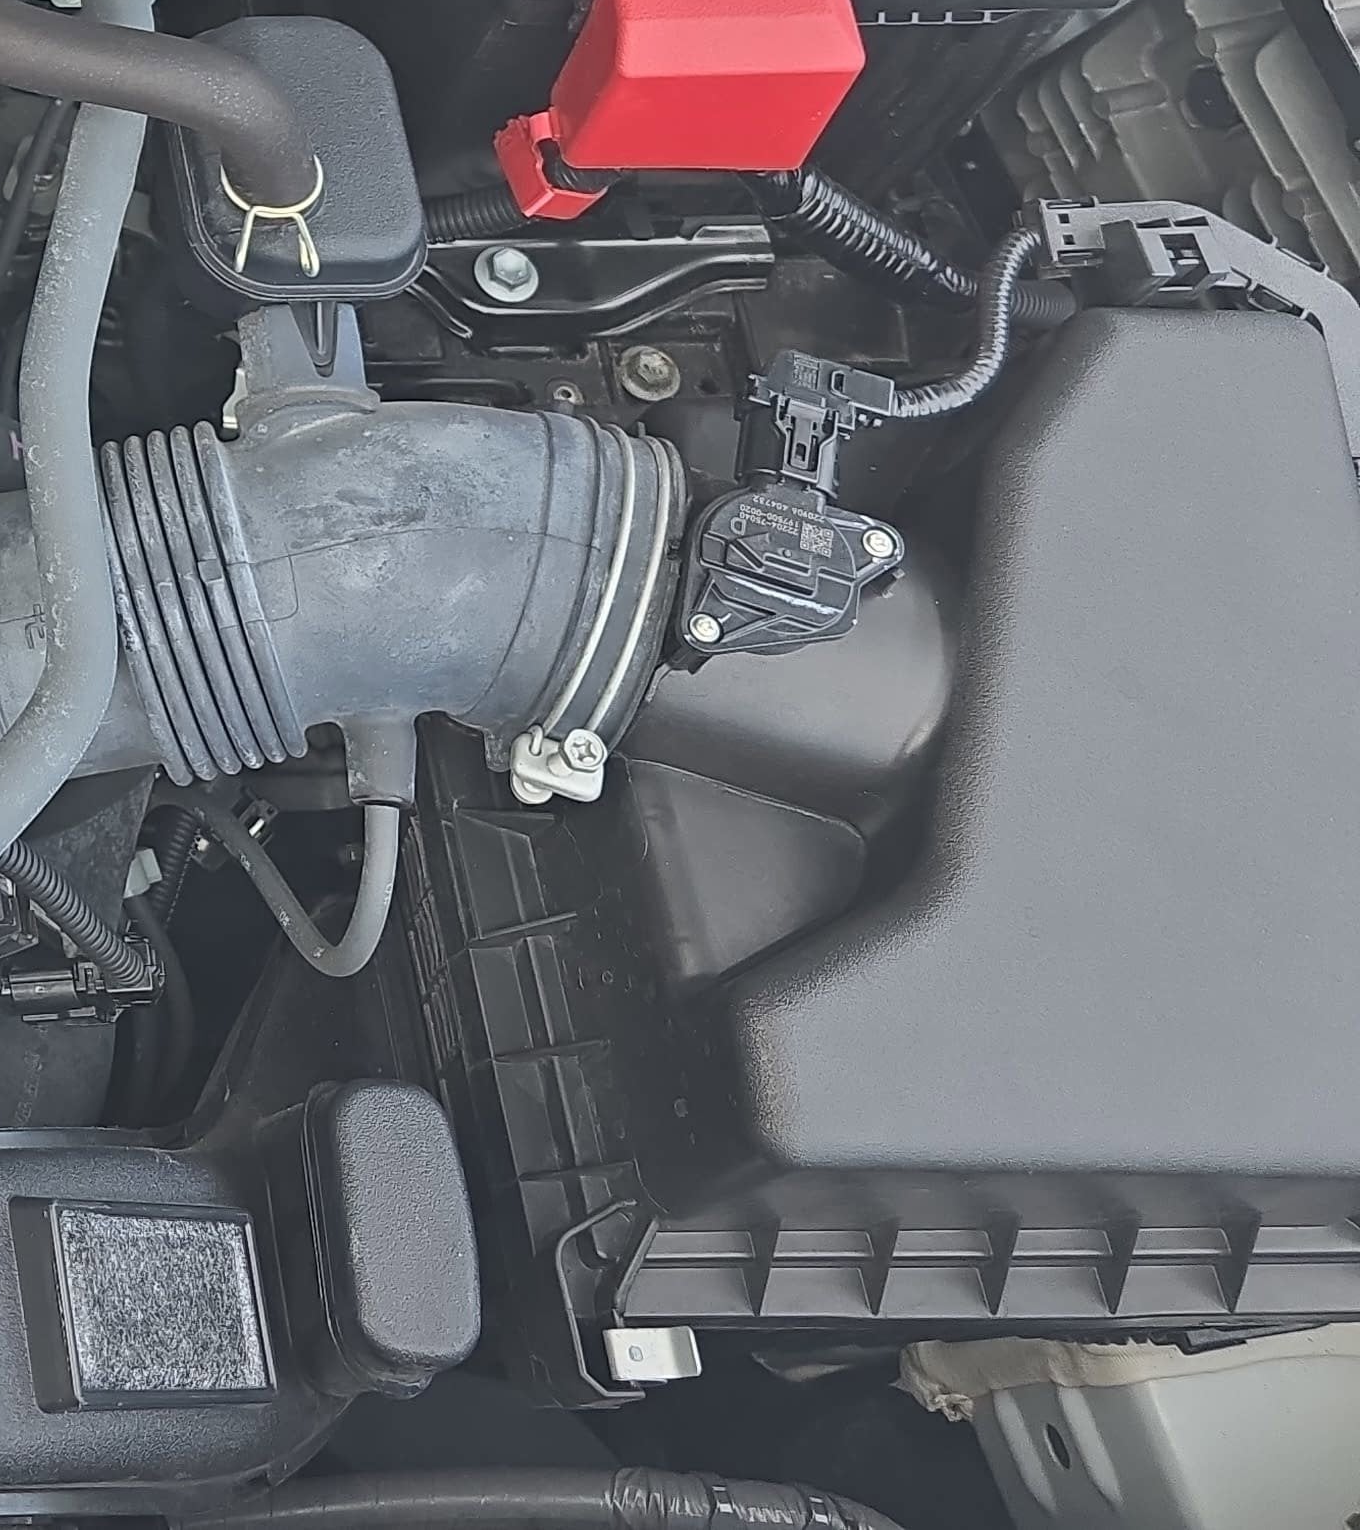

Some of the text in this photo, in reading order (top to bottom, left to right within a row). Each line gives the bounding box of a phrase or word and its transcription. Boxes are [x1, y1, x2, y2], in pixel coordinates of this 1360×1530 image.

[730, 515, 745, 535] D
[738, 503, 799, 526] 197500-0020
[738, 511, 798, 535] 22204-75040
